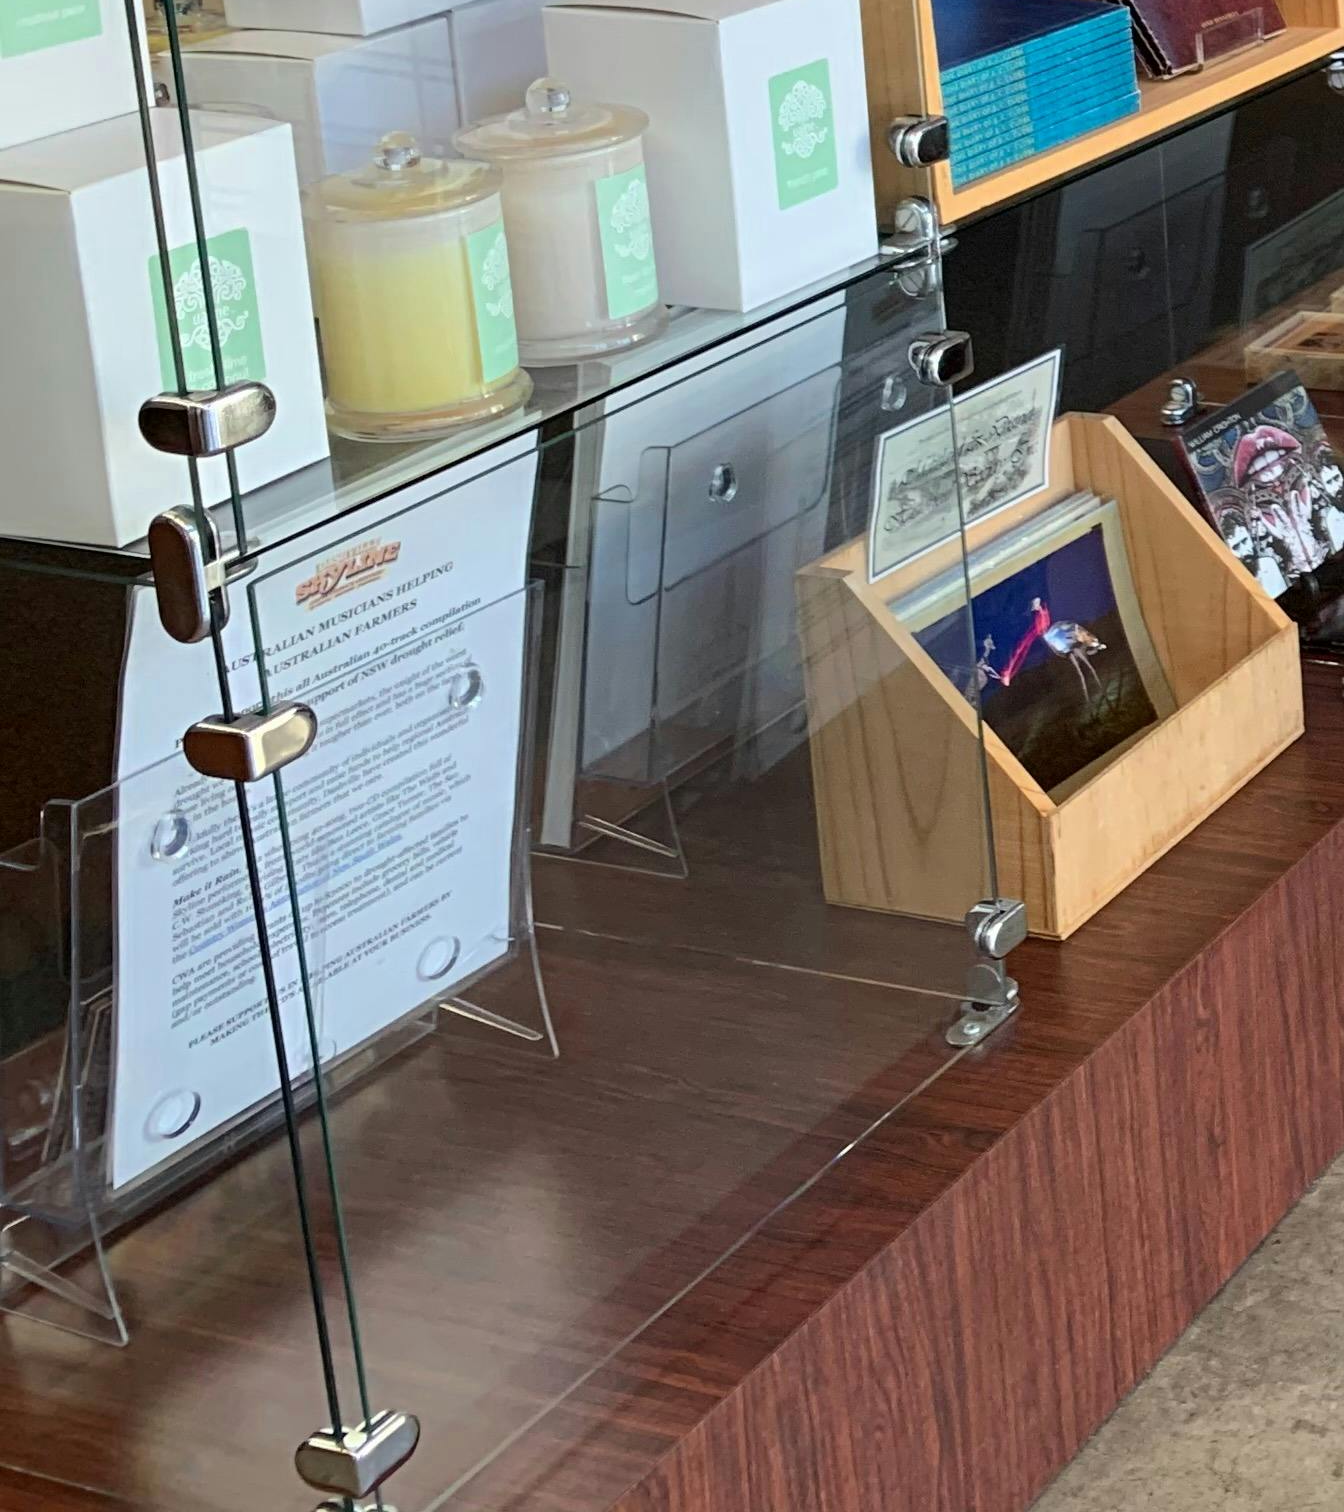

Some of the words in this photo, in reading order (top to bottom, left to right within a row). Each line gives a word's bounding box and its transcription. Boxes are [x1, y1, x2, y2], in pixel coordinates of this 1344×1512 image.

[318, 589, 395, 632] MUSICIANS
[396, 561, 455, 597] HELPING
[265, 629, 352, 678] AUSTRALIAN
[353, 598, 419, 637] FARMERS
[271, 686, 294, 703] this
[312, 651, 372, 683] Australian
[372, 626, 419, 658] 40-track
[420, 596, 482, 633] compilation
[350, 671, 362, 686] of
[361, 662, 388, 680] NSW
[390, 641, 433, 667] drought
[174, 887, 201, 905] Make
[205, 881, 213, 889] it
[172, 967, 195, 985] CWA
[189, 1019, 225, 1048] PLEASE
